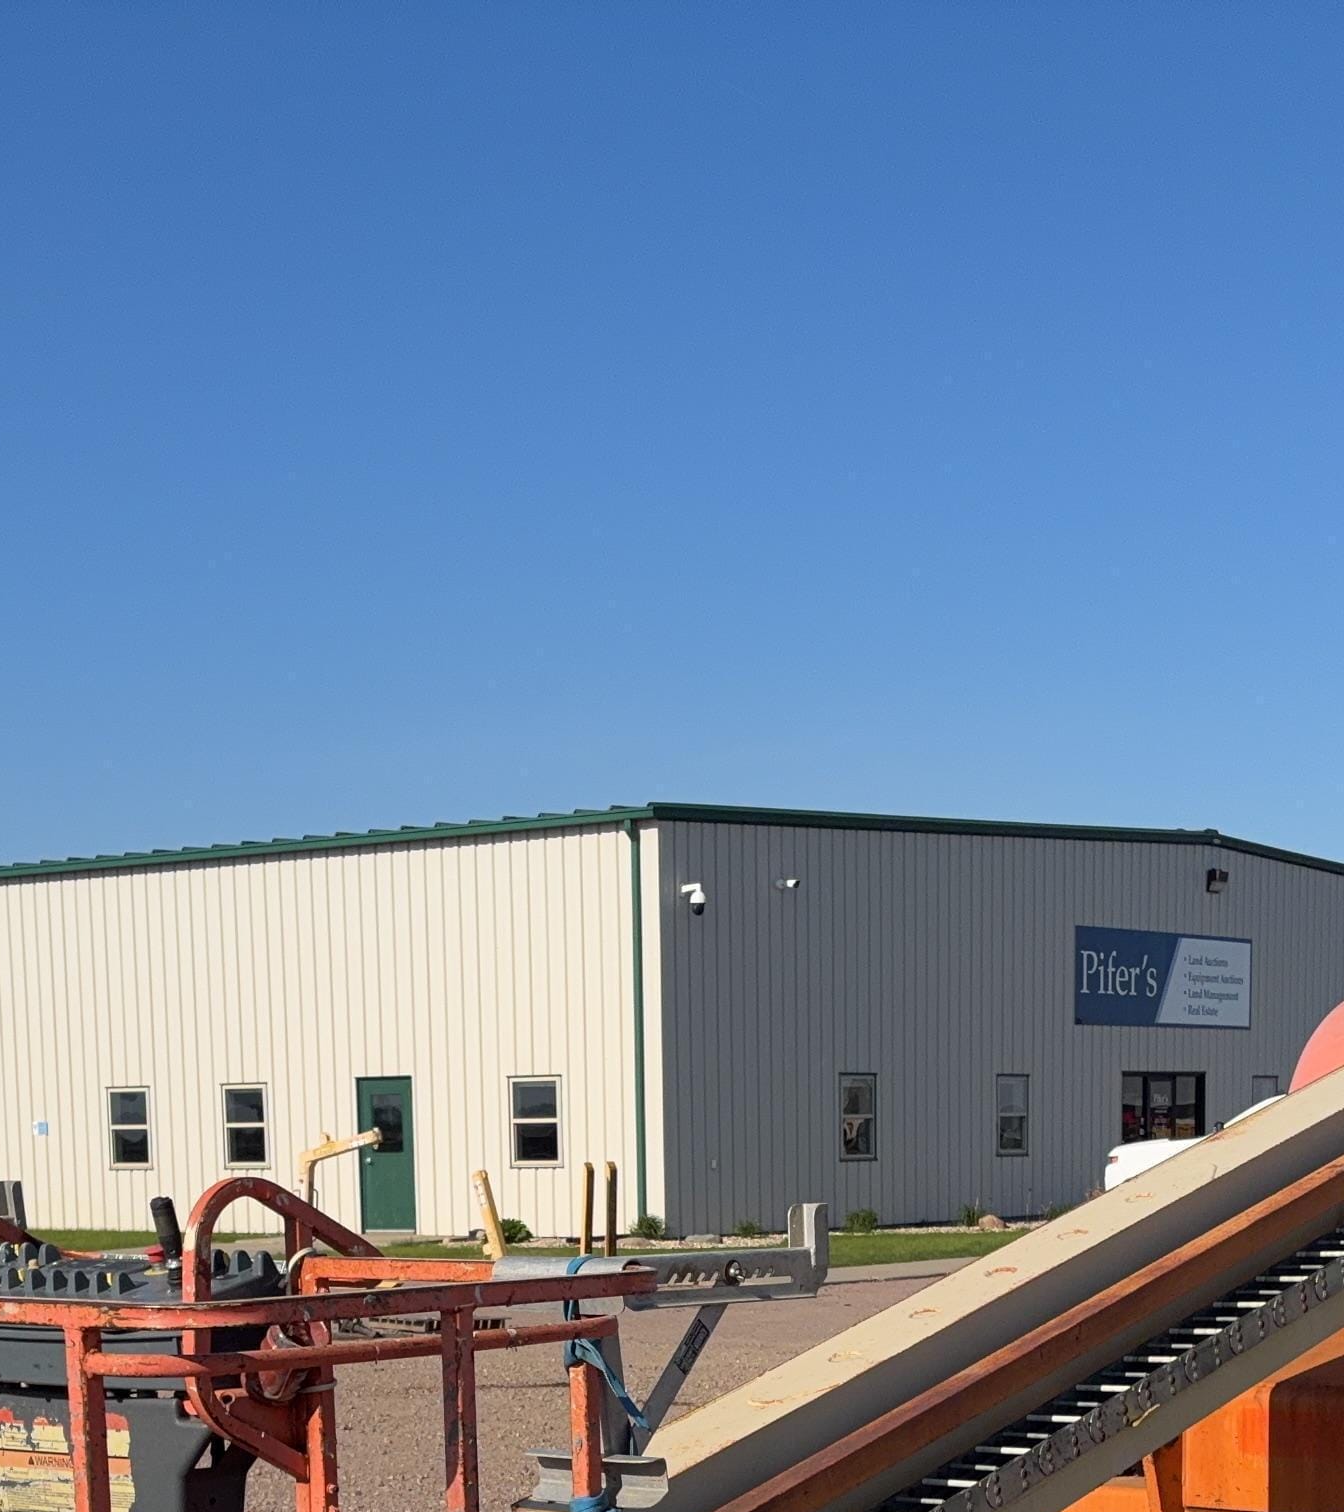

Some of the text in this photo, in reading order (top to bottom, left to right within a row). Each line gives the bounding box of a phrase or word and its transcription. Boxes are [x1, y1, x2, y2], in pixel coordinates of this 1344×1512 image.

[1188, 954, 1229, 968] Land Auctions
[1079, 949, 1157, 998] Pifer's
[1188, 971, 1244, 986] Equipment Auctions
[1188, 988, 1239, 1003] Land Management
